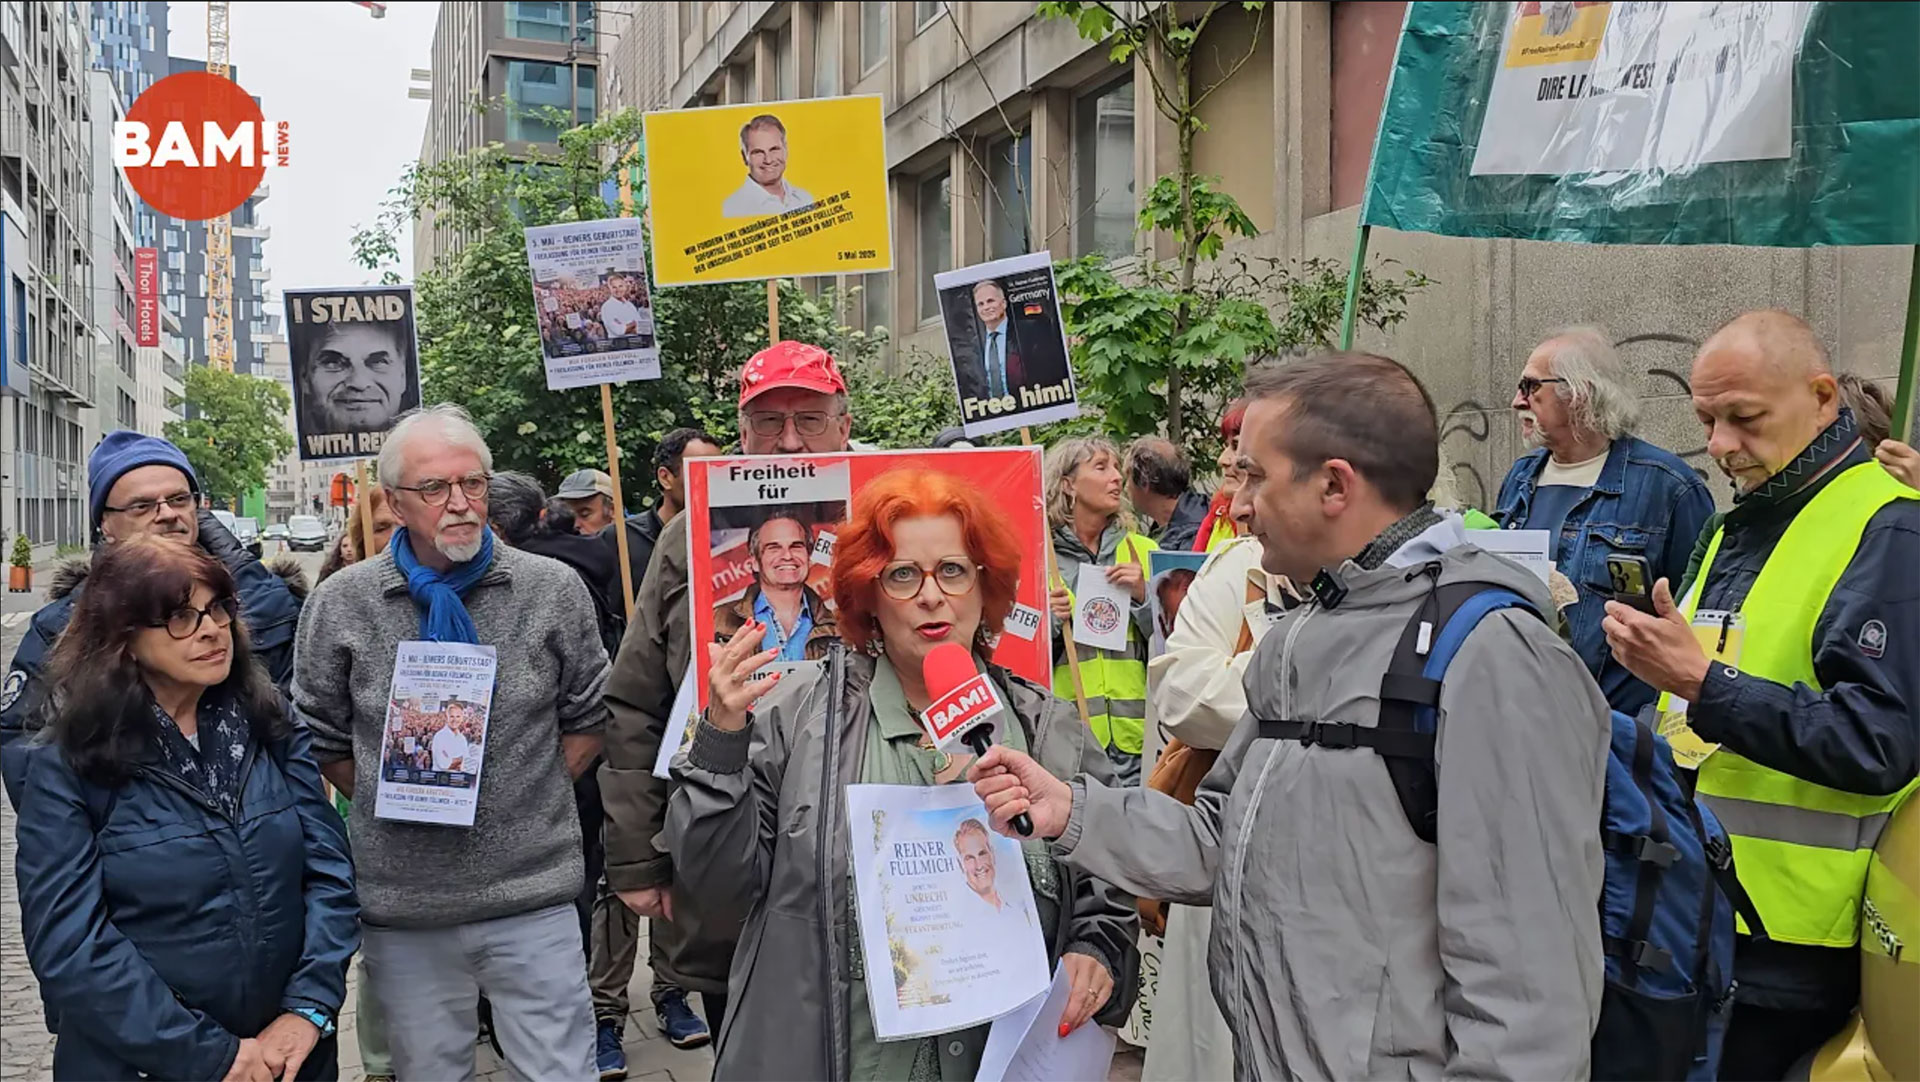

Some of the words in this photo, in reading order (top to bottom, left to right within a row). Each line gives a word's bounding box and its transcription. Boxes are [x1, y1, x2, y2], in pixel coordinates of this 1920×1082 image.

[1537, 76, 1567, 101] DIRE
[563, 233, 592, 244] REINERS
[139, 262, 154, 295] Thon
[1008, 288, 1050, 303] Germany
[140, 299, 155, 342] Hotels
[293, 298, 304, 324] I
[310, 295, 405, 324] STAND
[963, 394, 1017, 420] Free
[1019, 377, 1073, 409] him!
[307, 433, 354, 456] WITH
[358, 431, 389, 453] REI
[729, 463, 817, 482] Freiheit
[757, 484, 790, 501] für
[932, 685, 989, 731] BAM!
[894, 841, 946, 858] REINER
[905, 891, 949, 904] UNRECHT
